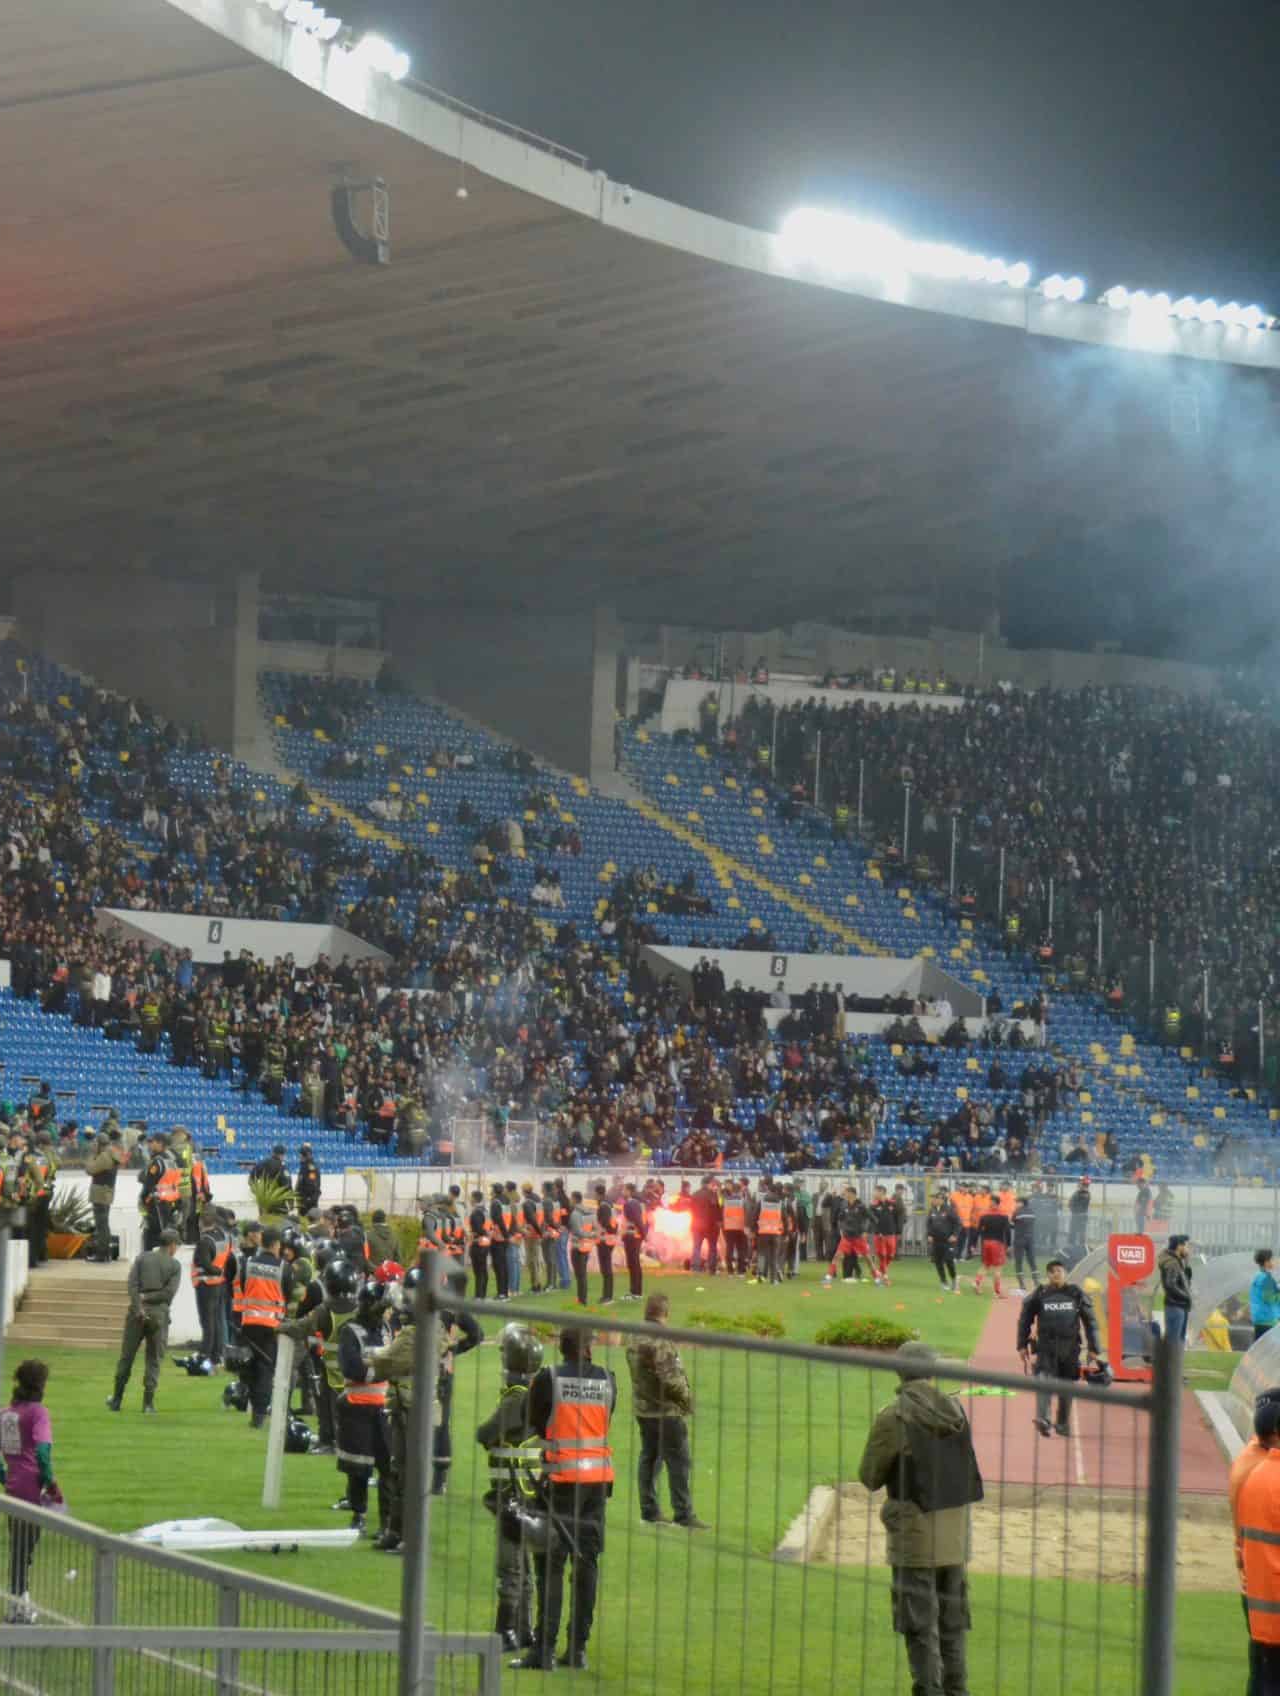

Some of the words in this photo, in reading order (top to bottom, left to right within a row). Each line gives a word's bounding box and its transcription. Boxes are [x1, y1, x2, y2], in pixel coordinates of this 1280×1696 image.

[211, 923, 219, 941] 6
[774, 959, 784, 974] 8
[1043, 1302, 1073, 1311] POLICE
